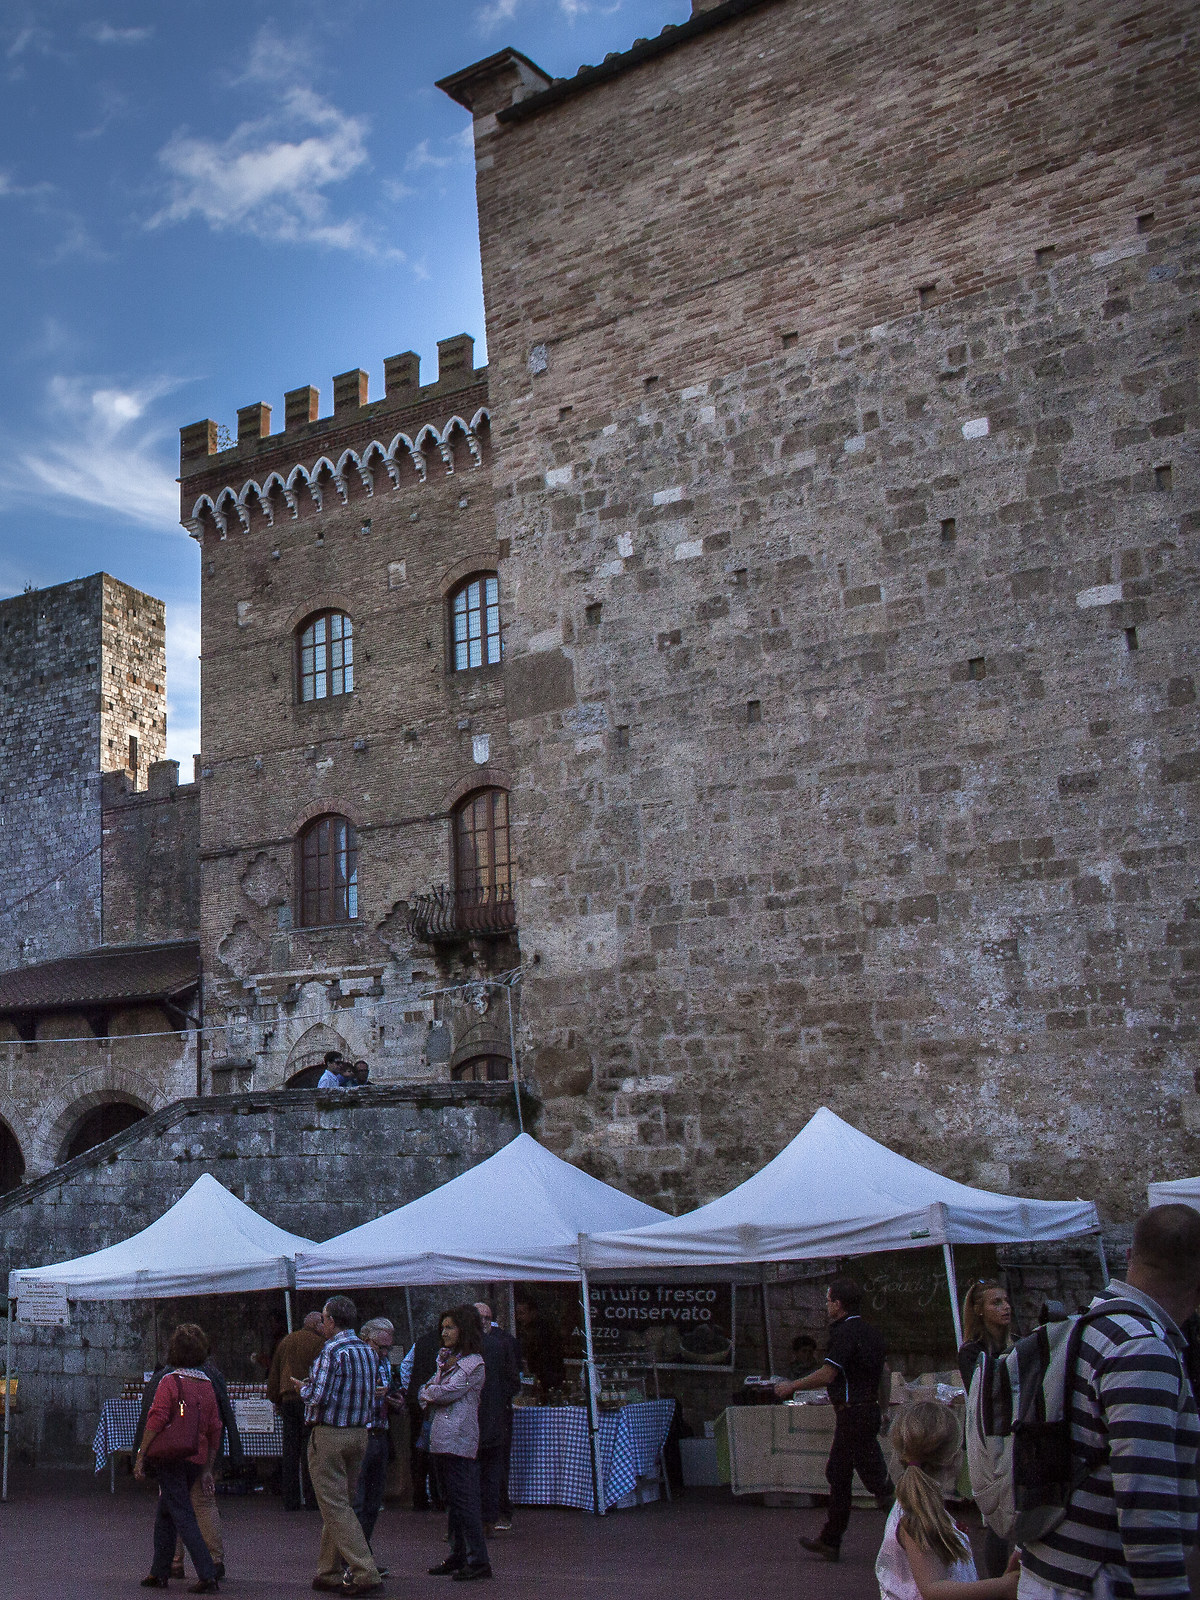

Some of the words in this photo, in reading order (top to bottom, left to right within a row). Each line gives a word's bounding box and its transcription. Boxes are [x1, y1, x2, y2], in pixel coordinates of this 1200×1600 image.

[588, 1286, 650, 1302] artufo
[656, 1286, 717, 1303] fresco
[604, 1306, 712, 1321] conservato
[571, 1326, 620, 1338] AEZZO
